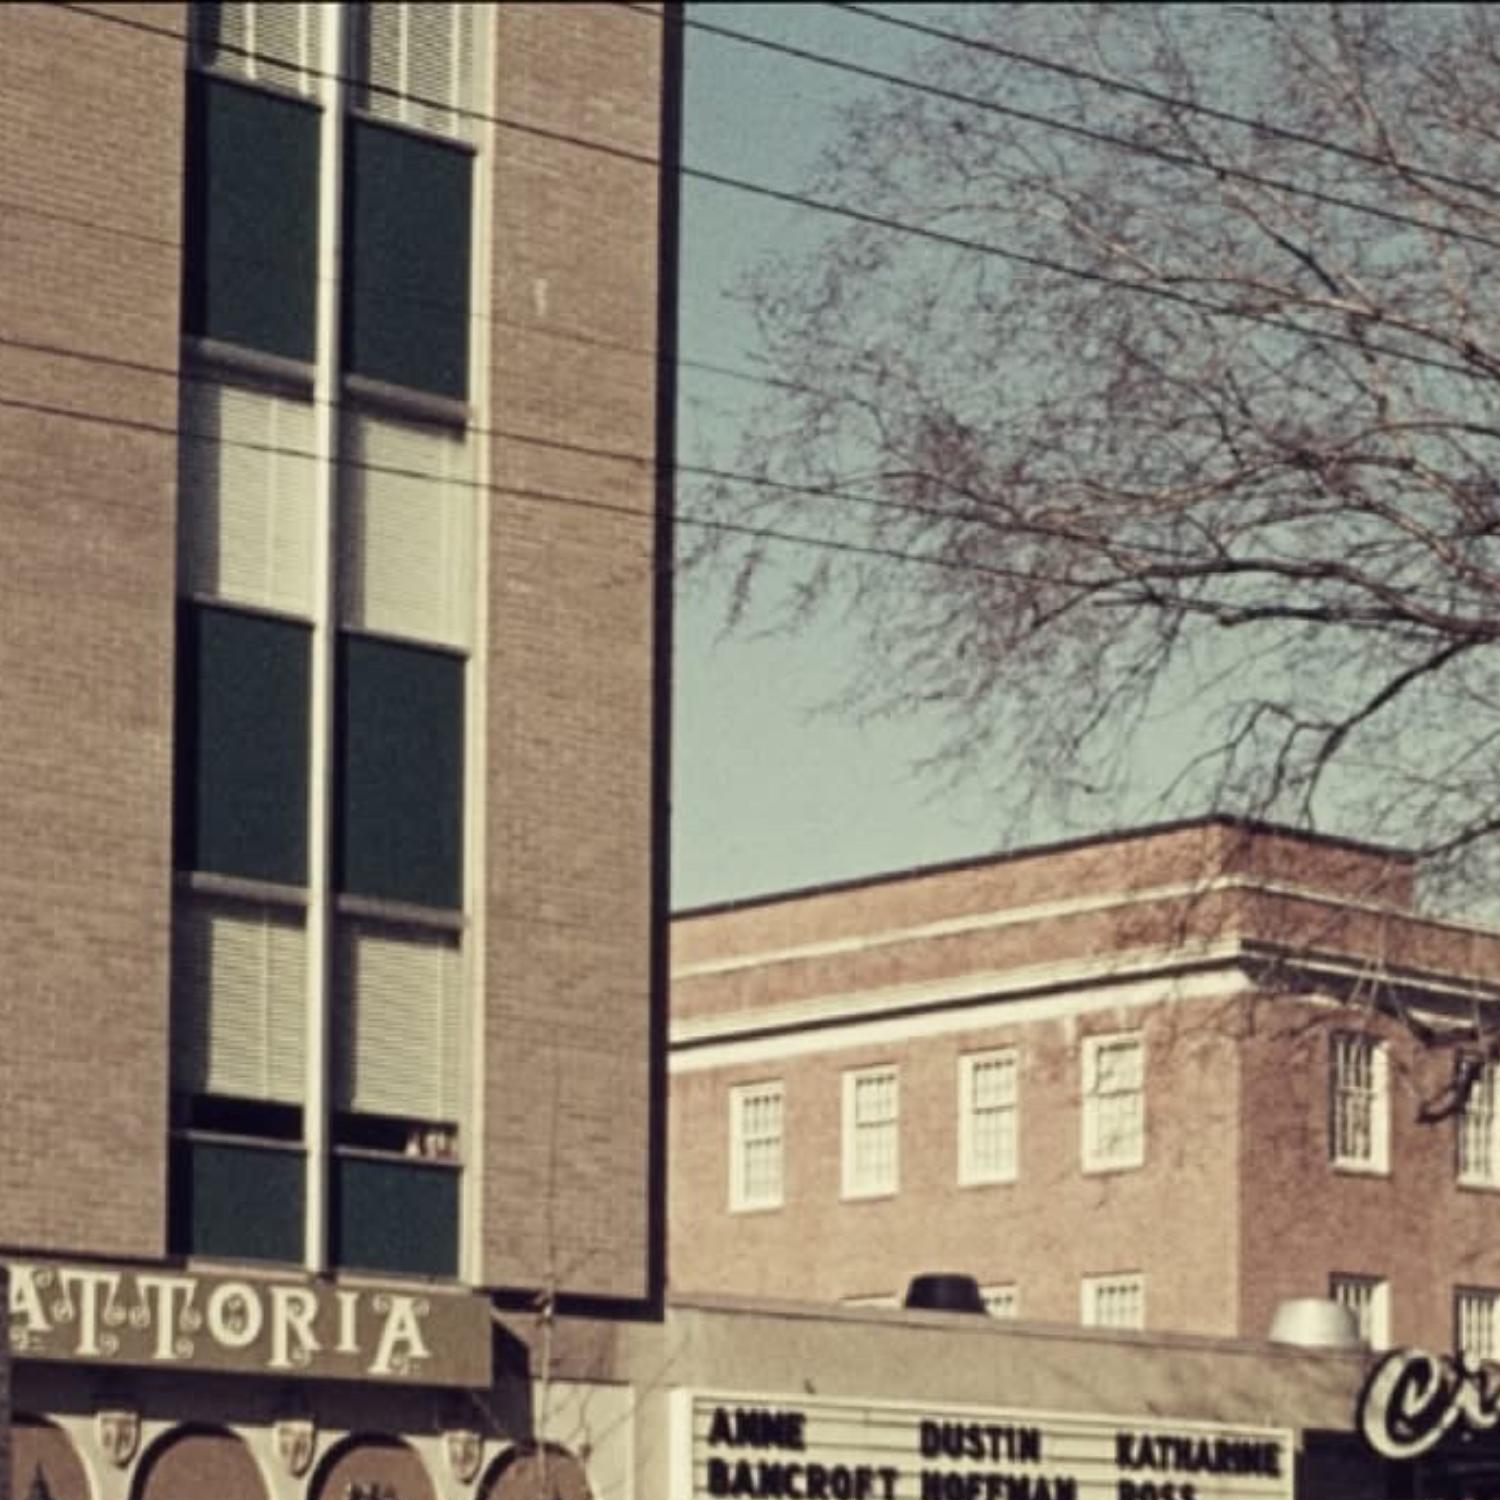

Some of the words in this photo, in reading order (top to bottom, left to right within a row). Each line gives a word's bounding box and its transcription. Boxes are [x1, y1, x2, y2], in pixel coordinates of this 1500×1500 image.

[8, 1263, 431, 1375] ATTORIA
[708, 1407, 806, 1451] ANNE
[920, 1420, 1041, 1463] DUSTIN
[1115, 1433, 1280, 1477] KATHARINE
